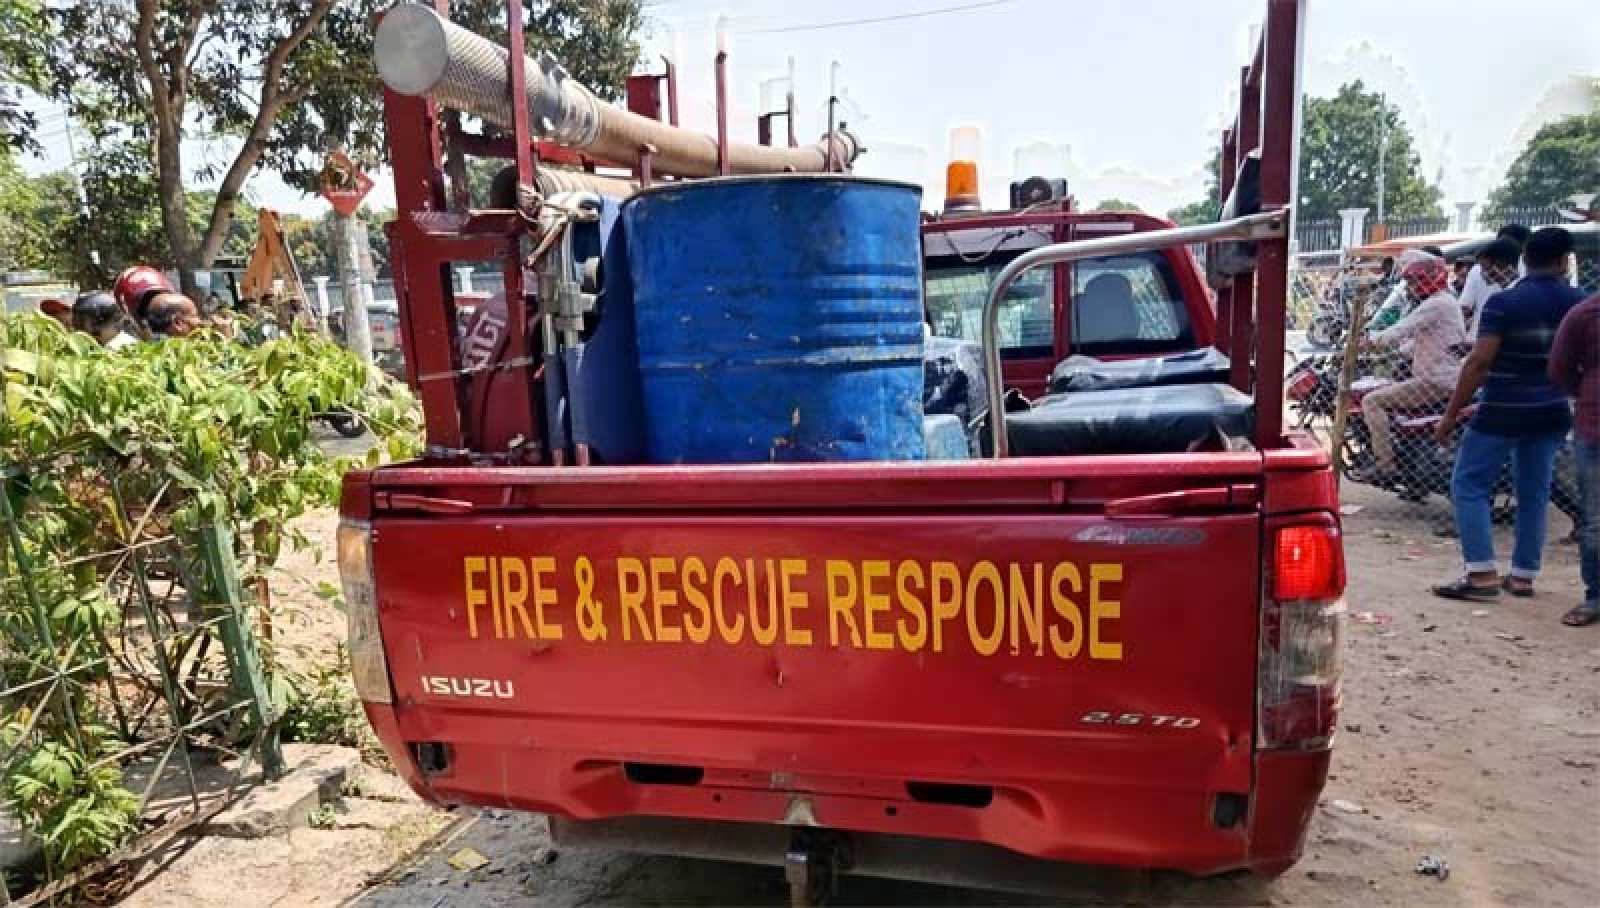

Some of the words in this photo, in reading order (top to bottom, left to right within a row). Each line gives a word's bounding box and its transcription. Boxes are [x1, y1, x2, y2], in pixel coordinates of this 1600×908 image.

[464, 557, 563, 640] FIRE
[575, 557, 607, 642] &
[617, 557, 812, 645] RESCUE
[826, 559, 1123, 660] RESPONSE
[421, 676, 514, 698] ISUZU
[1081, 711, 1143, 725] 2.5
[1151, 713, 1200, 729] TD
